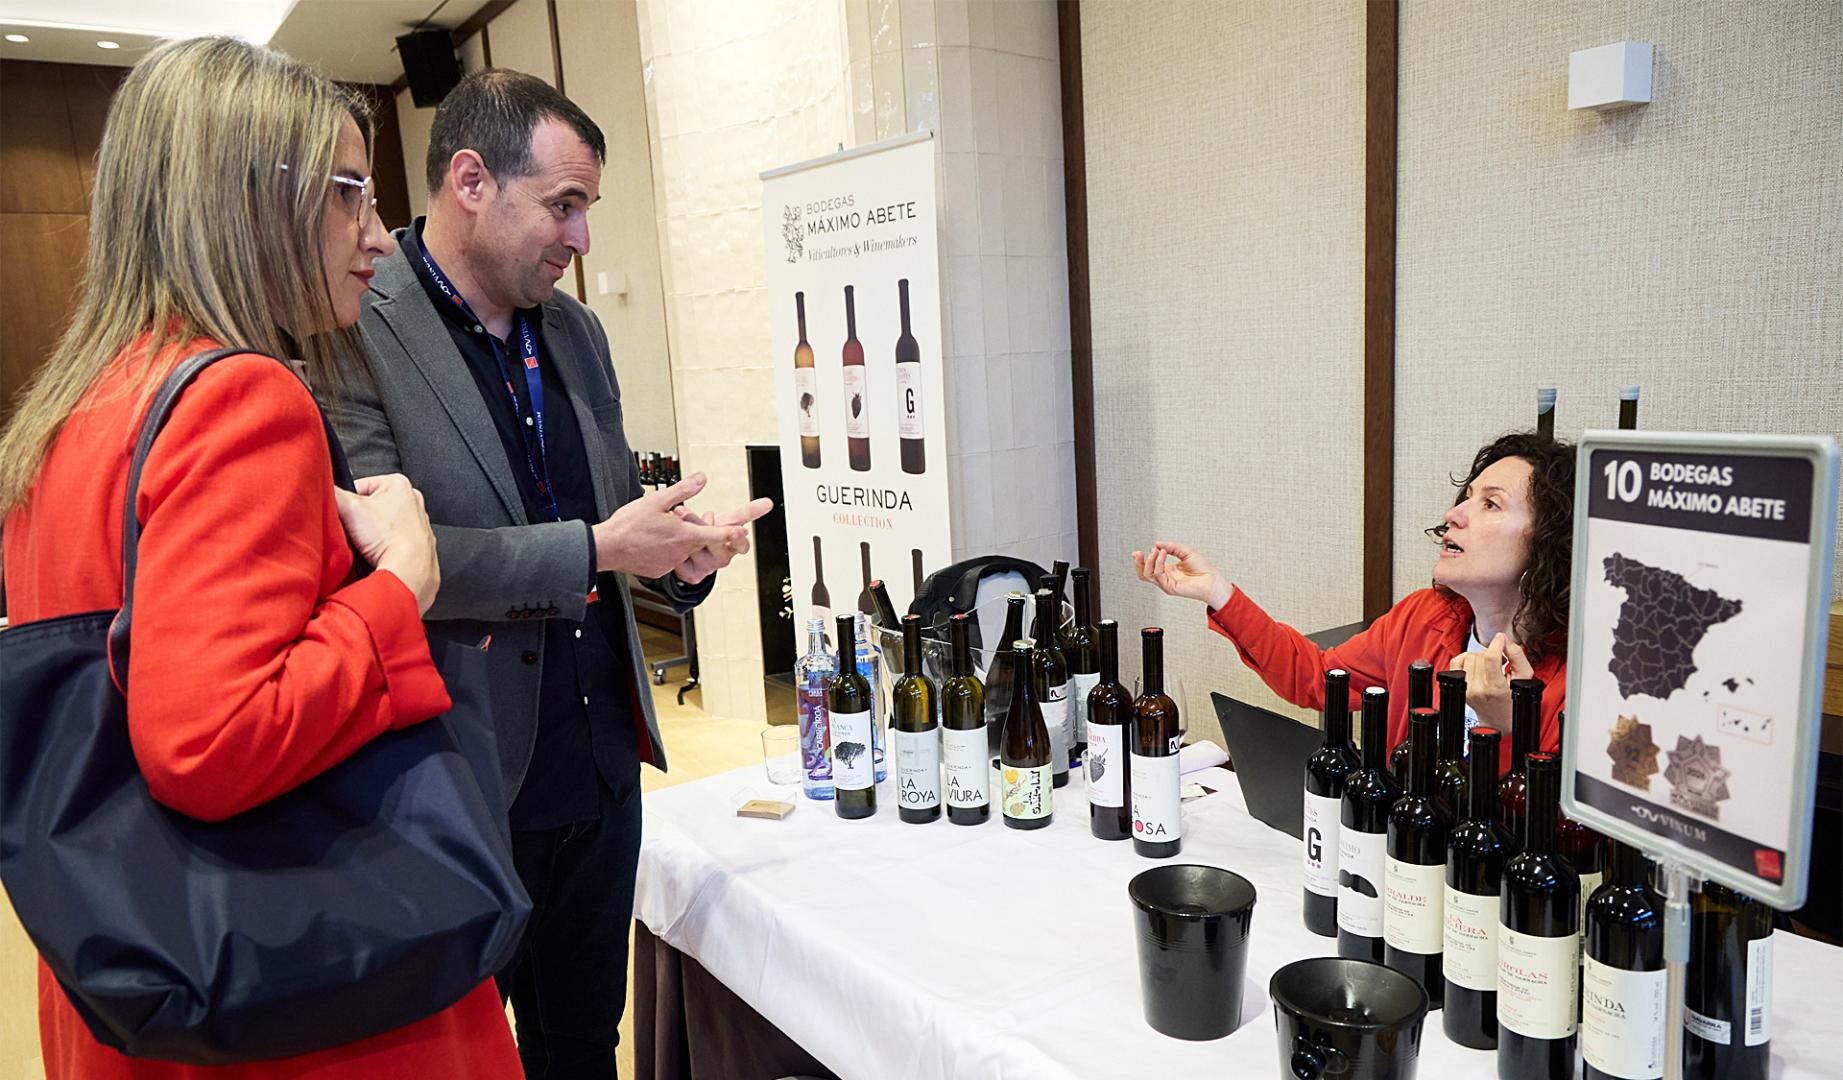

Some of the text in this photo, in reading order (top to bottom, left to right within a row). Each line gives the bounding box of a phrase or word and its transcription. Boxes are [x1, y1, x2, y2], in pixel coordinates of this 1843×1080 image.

[806, 194, 855, 215] BODEGAS
[807, 201, 917, 236] MÁXIMO ABETE
[863, 234, 918, 253] Winemakers
[905, 387, 916, 414] G
[1604, 460, 1643, 503] 10
[1650, 462, 1733, 486] BODEGAS
[816, 484, 913, 511] GUERINDA
[1647, 485, 1786, 521] MÁXIMO ABETE
[833, 512, 893, 529] COLLECTION
[901, 776, 916, 789] LA
[947, 774, 960, 788] LA
[901, 789, 936, 803] ROYA
[947, 789, 983, 802] VIURA
[1308, 827, 1322, 862] G
